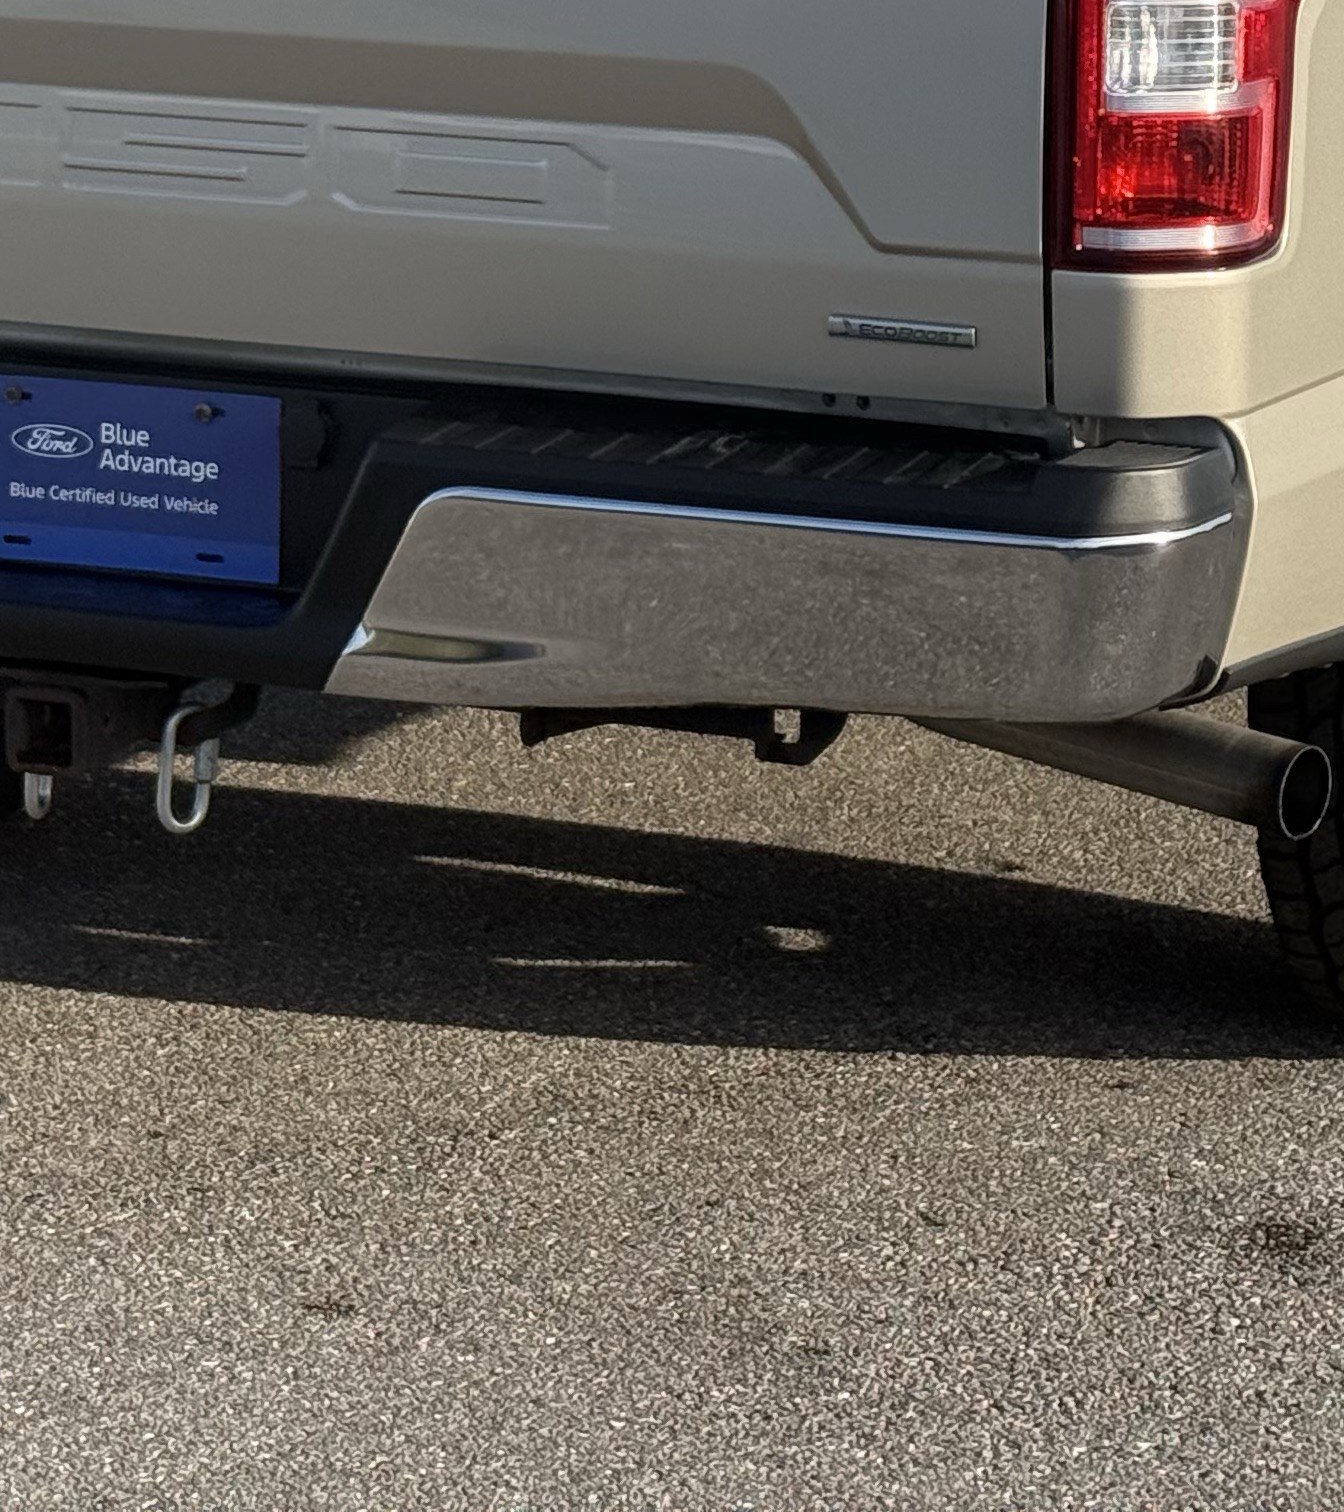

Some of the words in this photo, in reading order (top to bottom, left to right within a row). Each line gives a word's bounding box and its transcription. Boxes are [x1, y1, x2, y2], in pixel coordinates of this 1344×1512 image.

[27, 428, 78, 453] Ford
[100, 422, 150, 448] Blue
[99, 448, 220, 484] Advantage
[9, 481, 46, 499] Blue
[48, 484, 116, 506] Certified
[119, 490, 159, 510] Used
[163, 494, 219, 516] Vehicle
